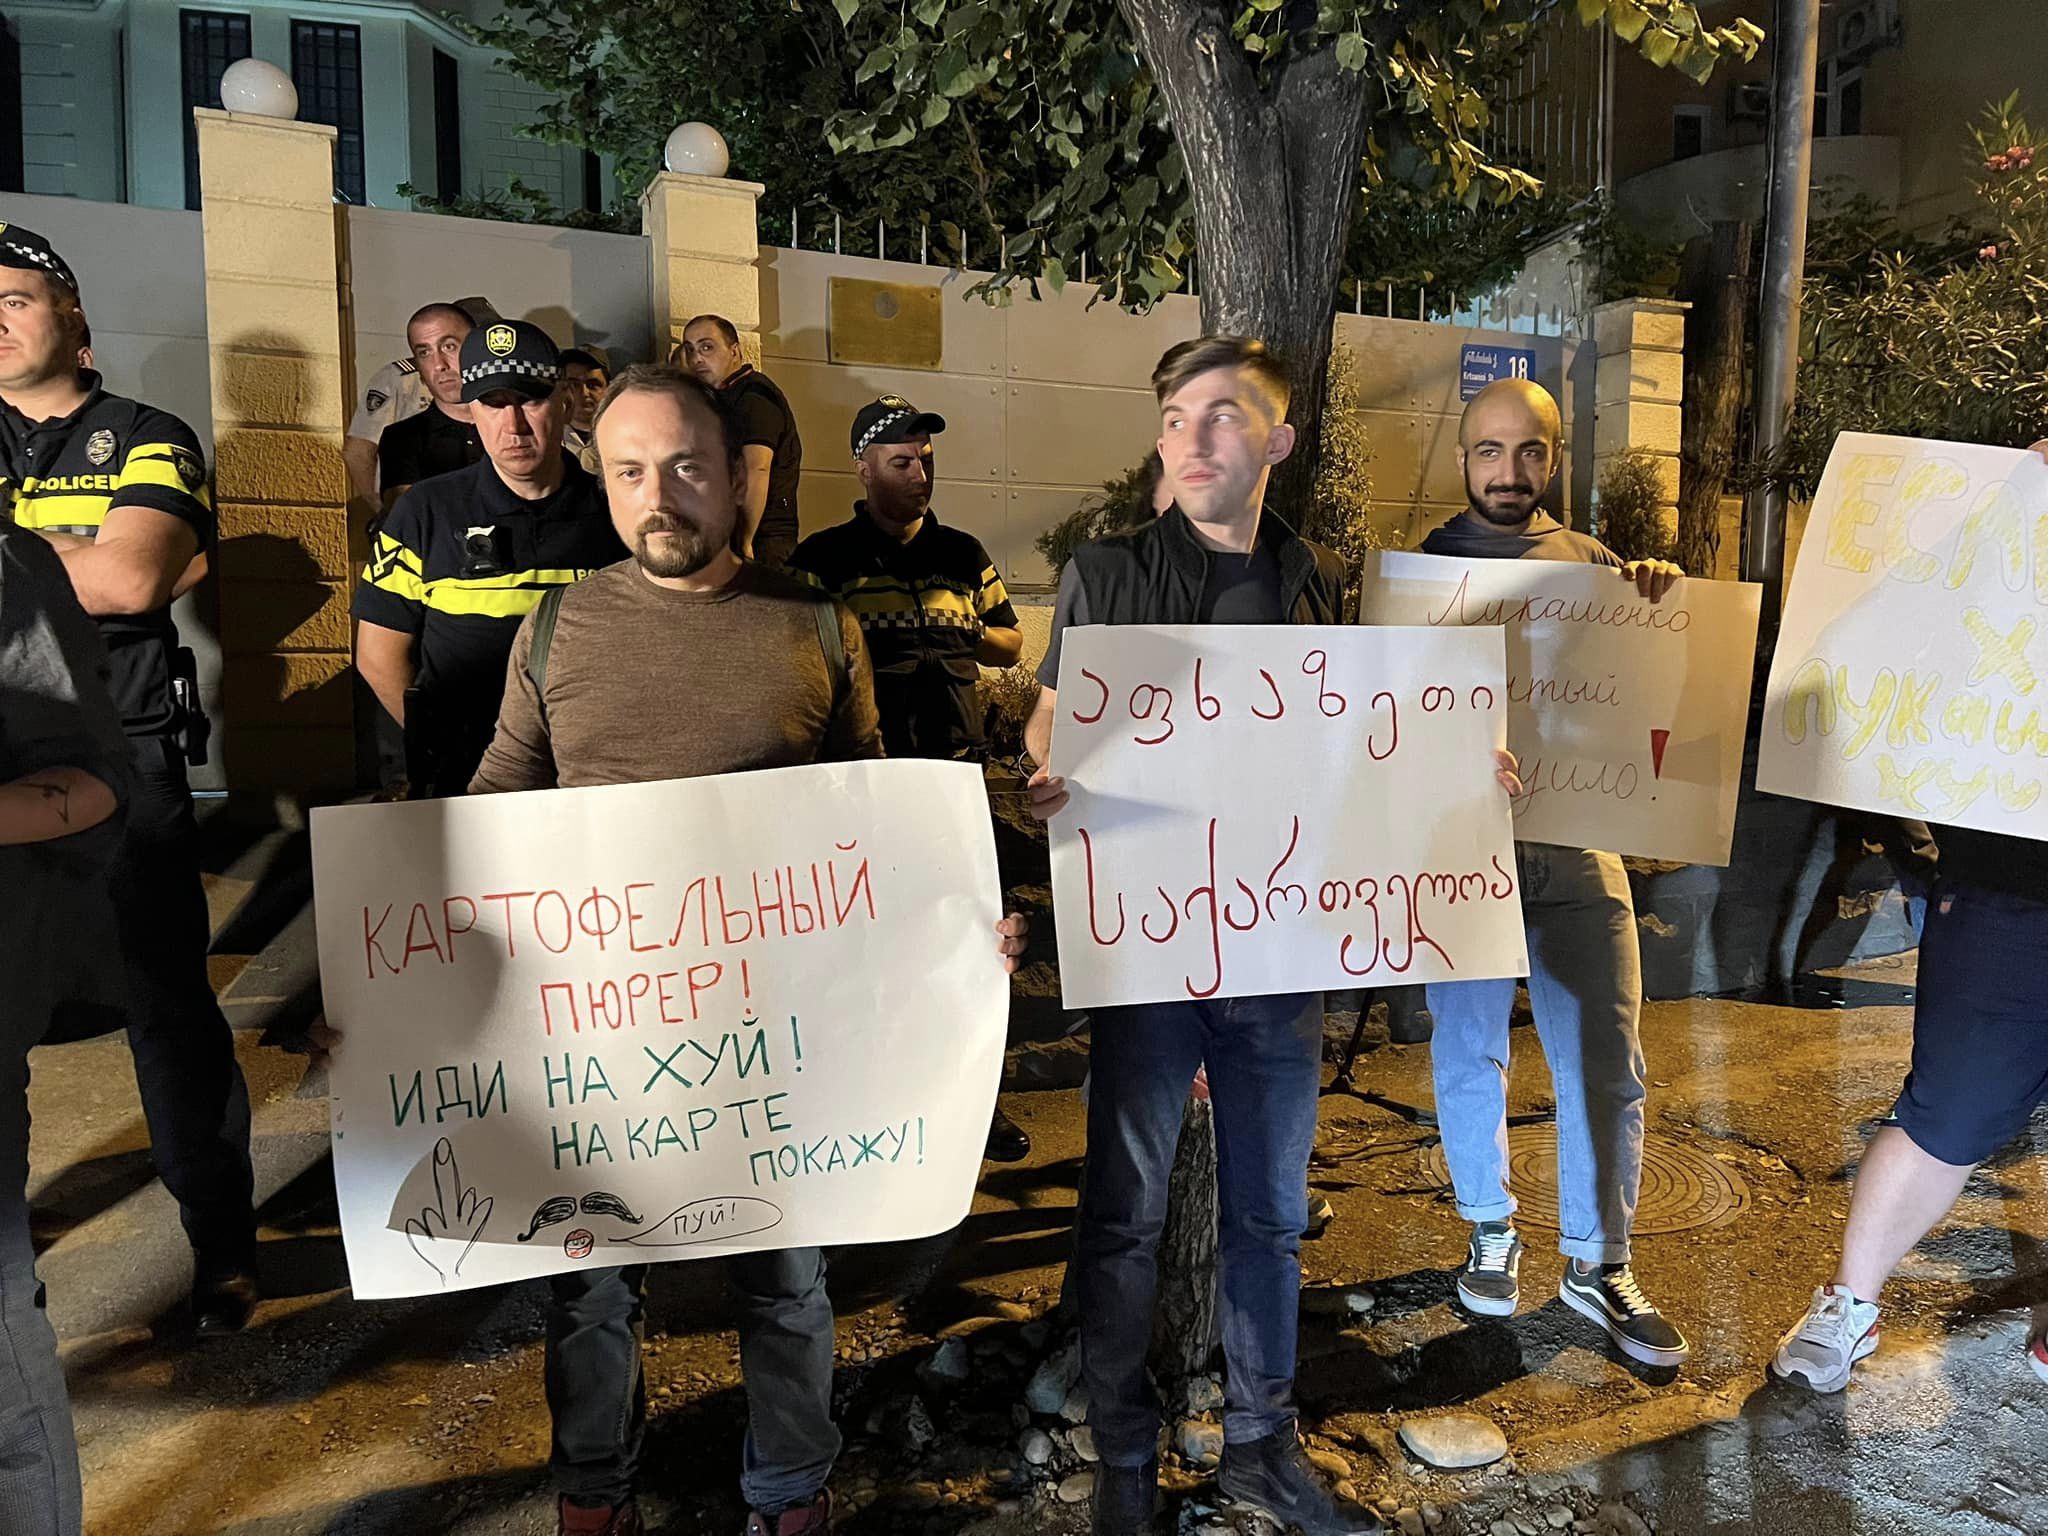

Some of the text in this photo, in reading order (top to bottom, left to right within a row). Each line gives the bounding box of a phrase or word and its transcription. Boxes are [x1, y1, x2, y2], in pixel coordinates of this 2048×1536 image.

[1509, 356, 1528, 380] 18
[22, 474, 108, 493] POLICE
[1428, 570, 1690, 632] Лукашенко
[1072, 649, 1494, 760] აფხაზეთი
[1511, 728, 1670, 818] уило!
[363, 839, 876, 979] КАРТОФЕЛЬНЫЙ
[539, 958, 752, 1036] ПЮРЕР!
[388, 1016, 803, 1128] ИДИ НА ХУЙ!
[749, 1116, 925, 1186] ПОКАЖУ!
[673, 1203, 737, 1236] ПУЙ!
